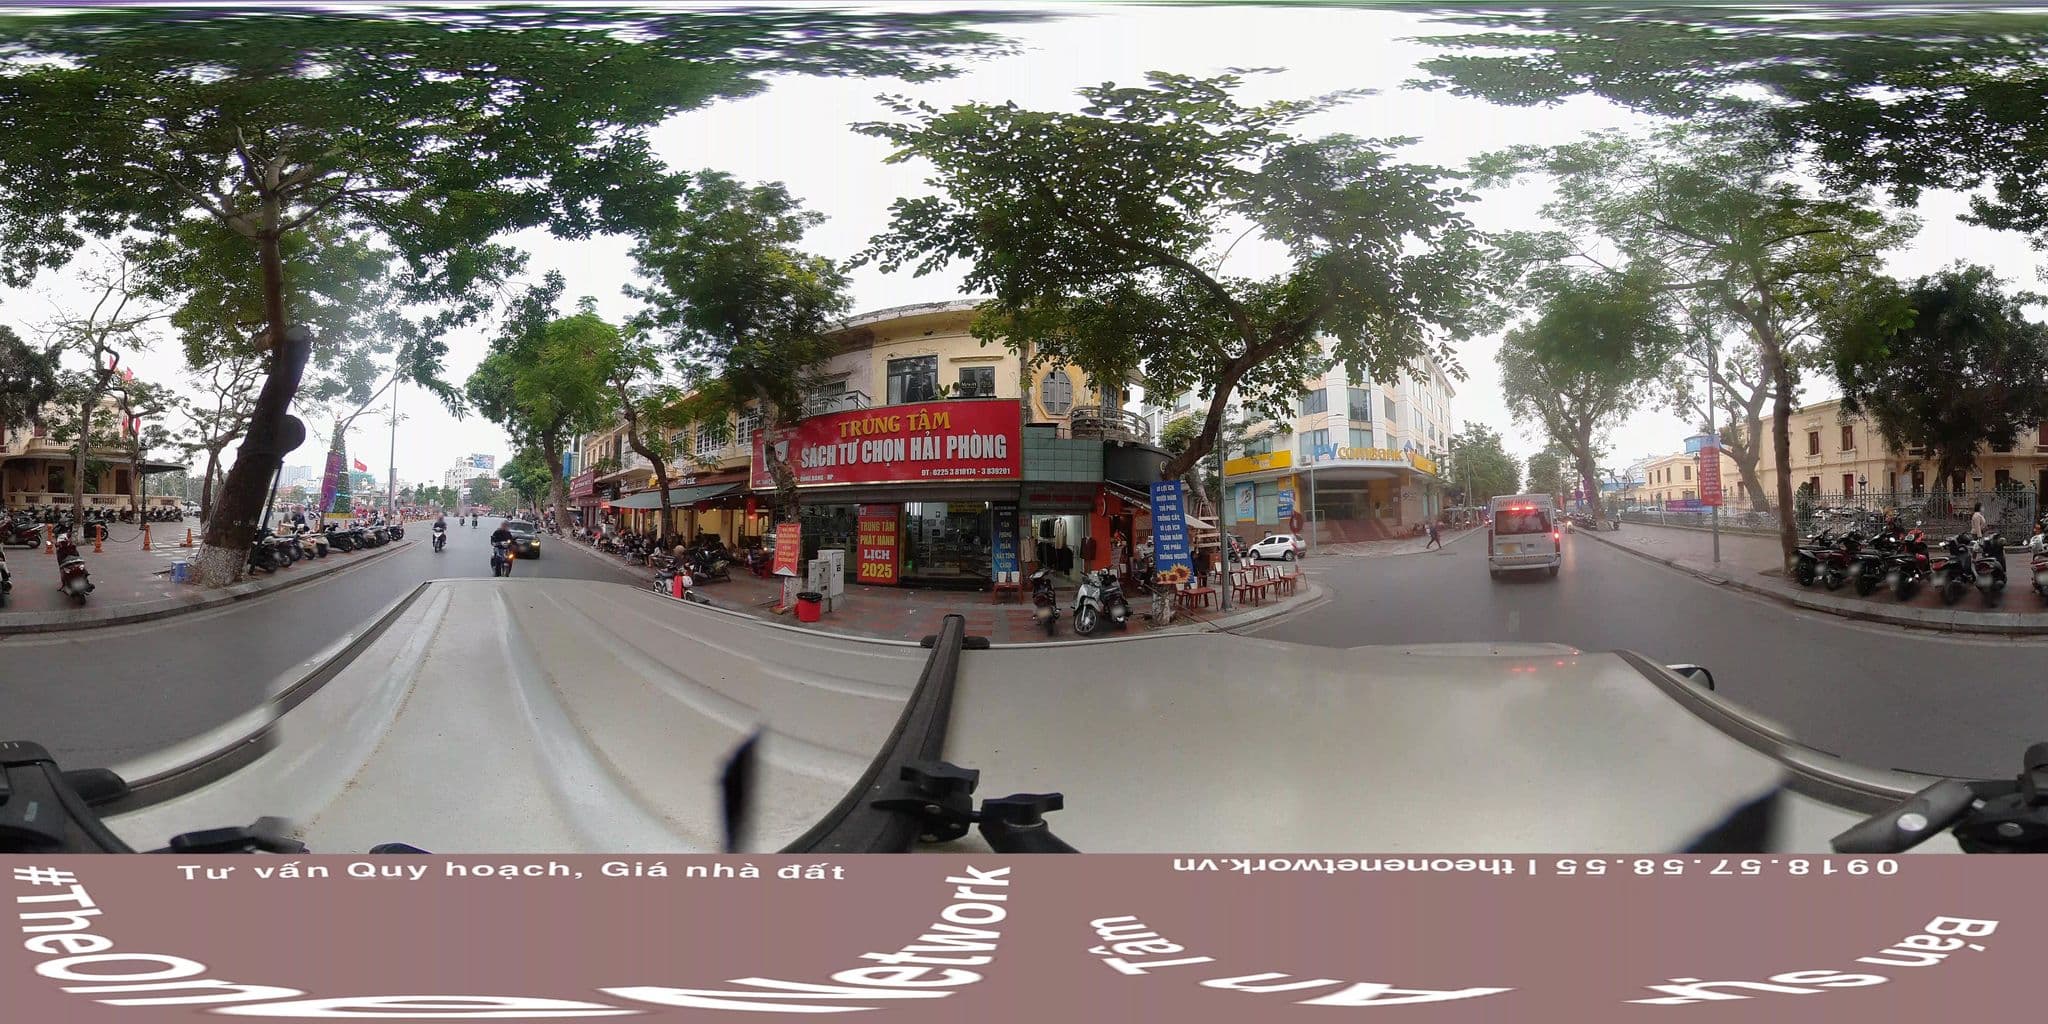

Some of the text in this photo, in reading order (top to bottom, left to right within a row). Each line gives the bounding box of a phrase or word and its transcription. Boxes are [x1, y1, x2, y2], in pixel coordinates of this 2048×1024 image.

[839, 408, 951, 438] TRUNG TÂM
[801, 443, 837, 468] SÁCH
[862, 438, 905, 467] CHỌN
[910, 431, 941, 460] HẢI
[946, 429, 1007, 459] PHÒNG
[861, 519, 896, 532] TRUNG TÂM
[860, 533, 876, 546] PHÁT
[864, 549, 890, 561] LỊCH
[862, 562, 893, 578] 2025
